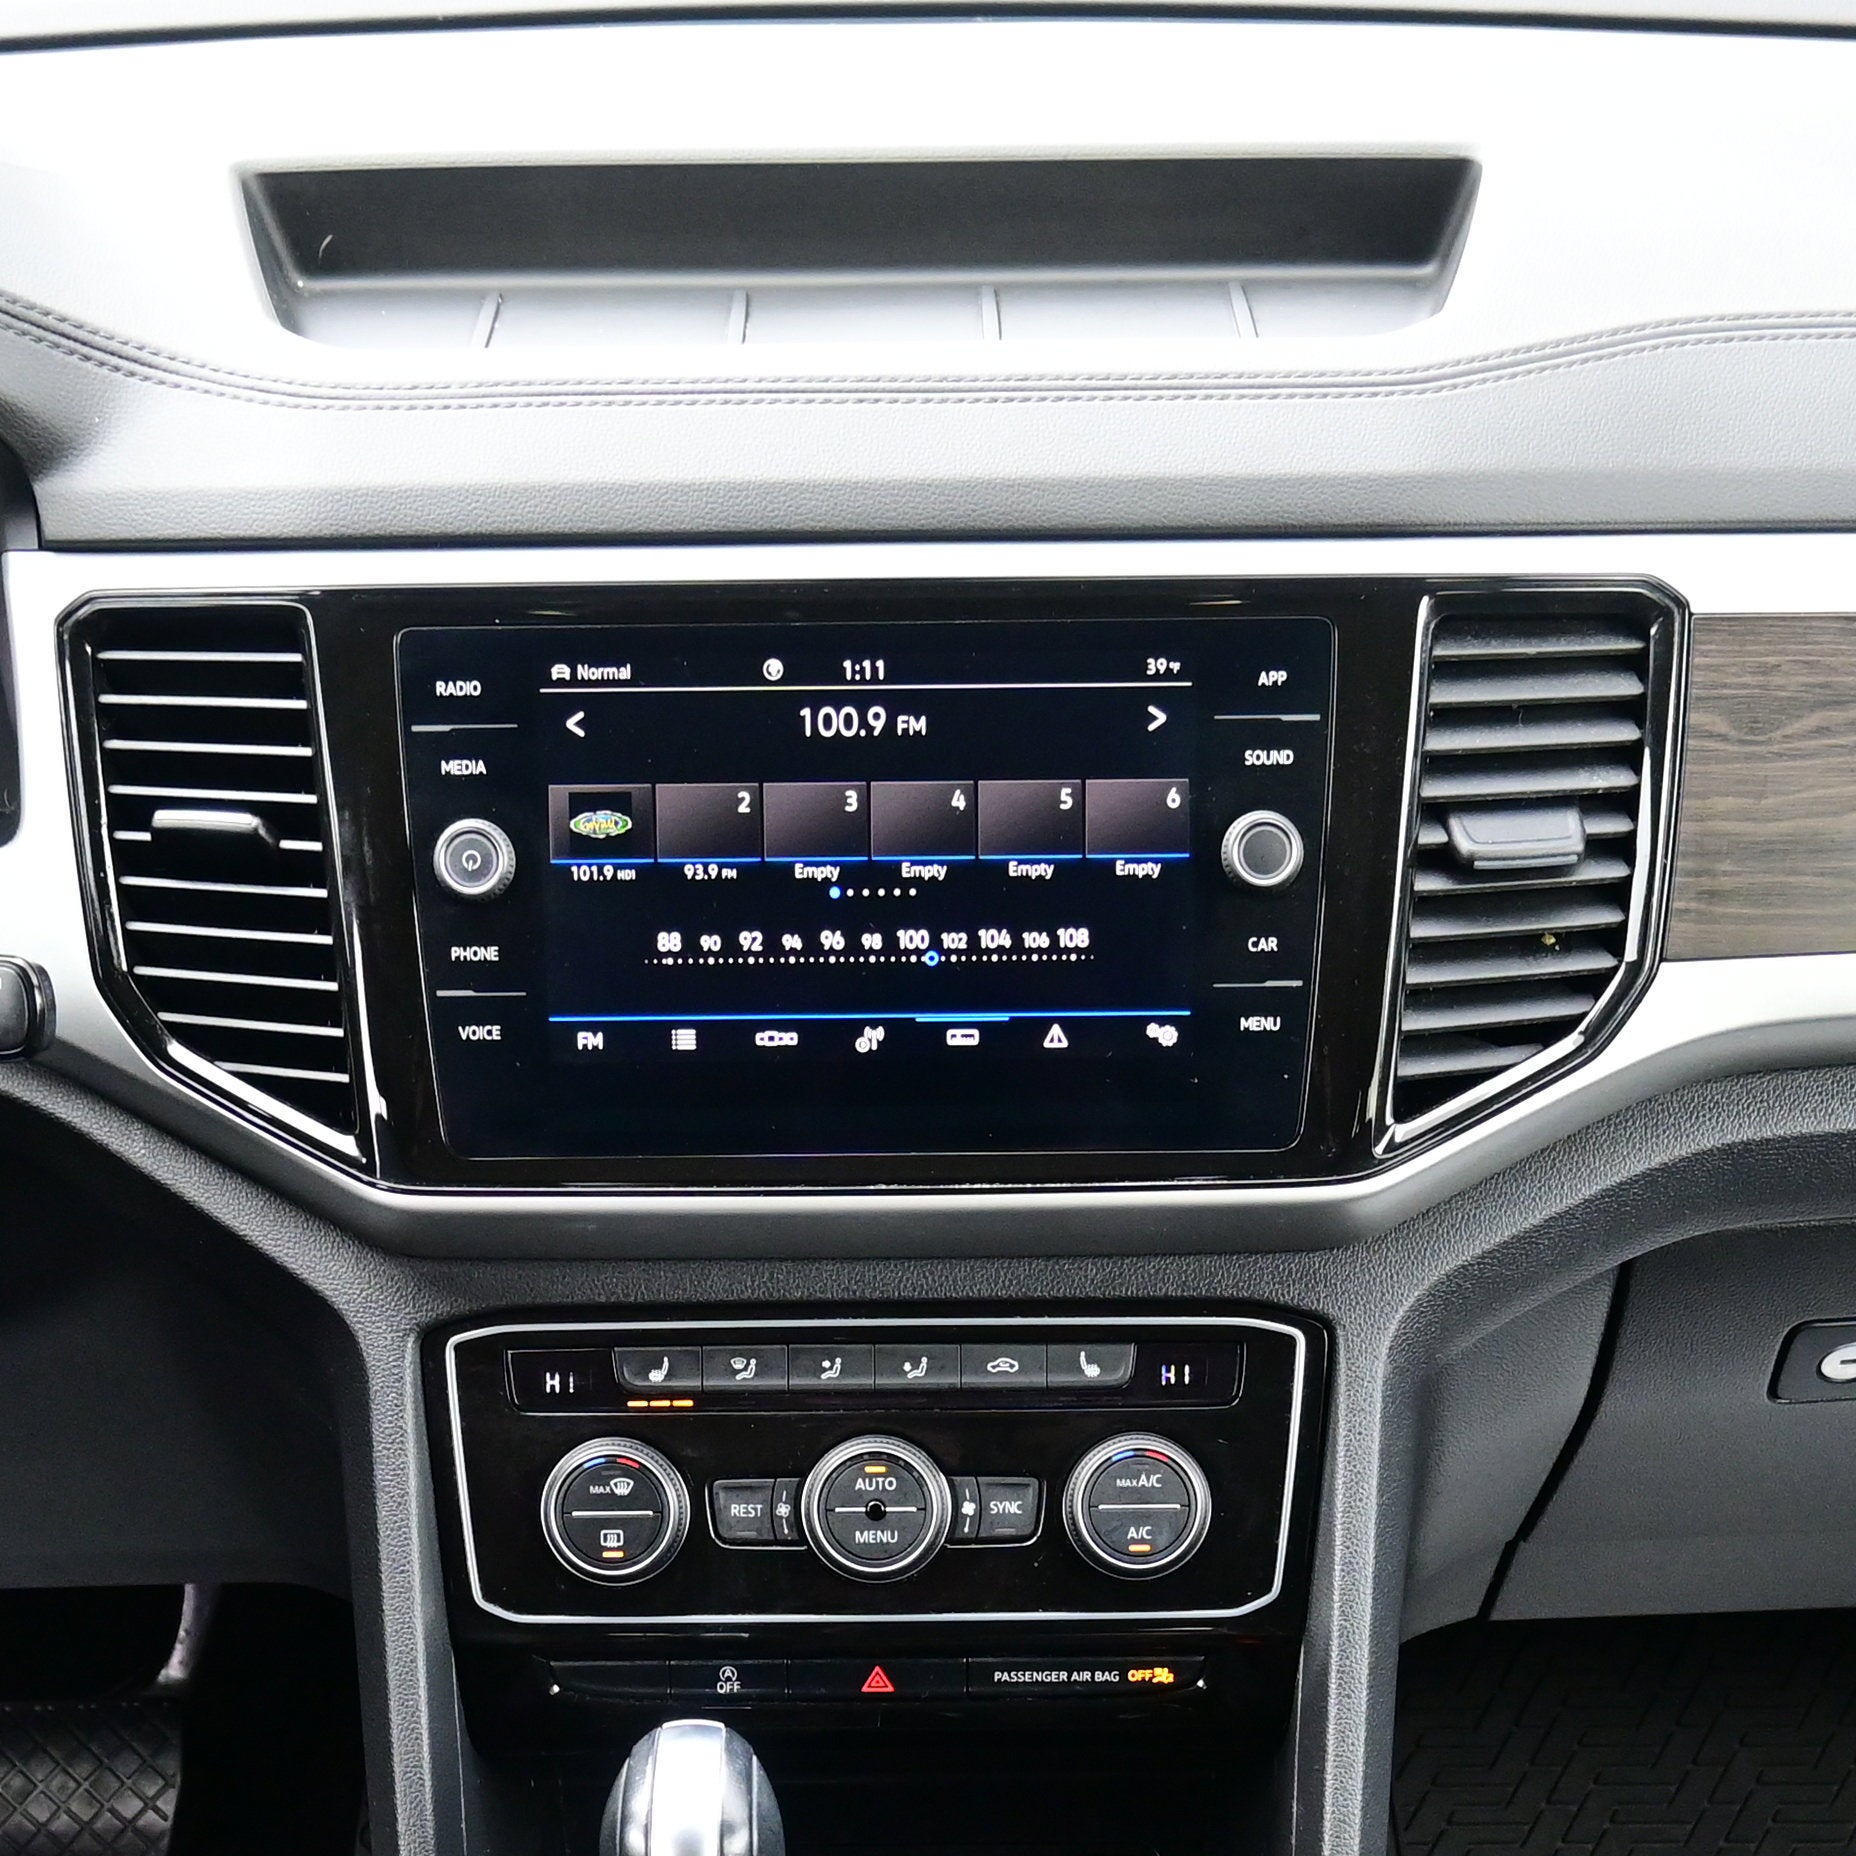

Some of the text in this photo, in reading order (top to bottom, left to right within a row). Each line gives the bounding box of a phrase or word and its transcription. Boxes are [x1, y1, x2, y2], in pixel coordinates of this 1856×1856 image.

[577, 664, 631, 680] Normal
[843, 659, 884, 680] 1:11
[1258, 671, 1287, 686] APP
[436, 680, 481, 696] RADIO
[800, 706, 926, 737] 100.9 FM
[1245, 750, 1294, 765] SOUND
[441, 760, 486, 775] MEDIA
[738, 791, 750, 813] 2
[845, 790, 857, 812] 3
[951, 789, 966, 810] 4
[1060, 787, 1072, 809] 5
[1167, 787, 1180, 808] 6
[571, 865, 613, 881] 101.9
[684, 865, 737, 881] 93.9 FM
[795, 863, 840, 882] Empty
[901, 863, 948, 881] Empty
[1009, 862, 1055, 880] Empty
[1115, 861, 1162, 878] Empty
[657, 927, 1089, 952] 88 90 92 94 96 98 100 102 104 106 108
[1248, 937, 1277, 951] CAR
[451, 946, 499, 961] PHONE
[1240, 1016, 1280, 1031] MENU
[458, 1025, 501, 1040] VOICE
[577, 1031, 603, 1050] FM
[855, 1477, 896, 1490] AUTO
[1117, 1472, 1162, 1488] MAX A/C
[590, 1485, 611, 1495] MAX
[731, 1504, 762, 1517] REST
[990, 1501, 1022, 1513] SYNC
[856, 1530, 898, 1543] MENU
[1127, 1526, 1152, 1539] A/C
[994, 1669, 1153, 1683] PASSENGER AIR BAG OFF
[717, 1681, 741, 1694] OFF
